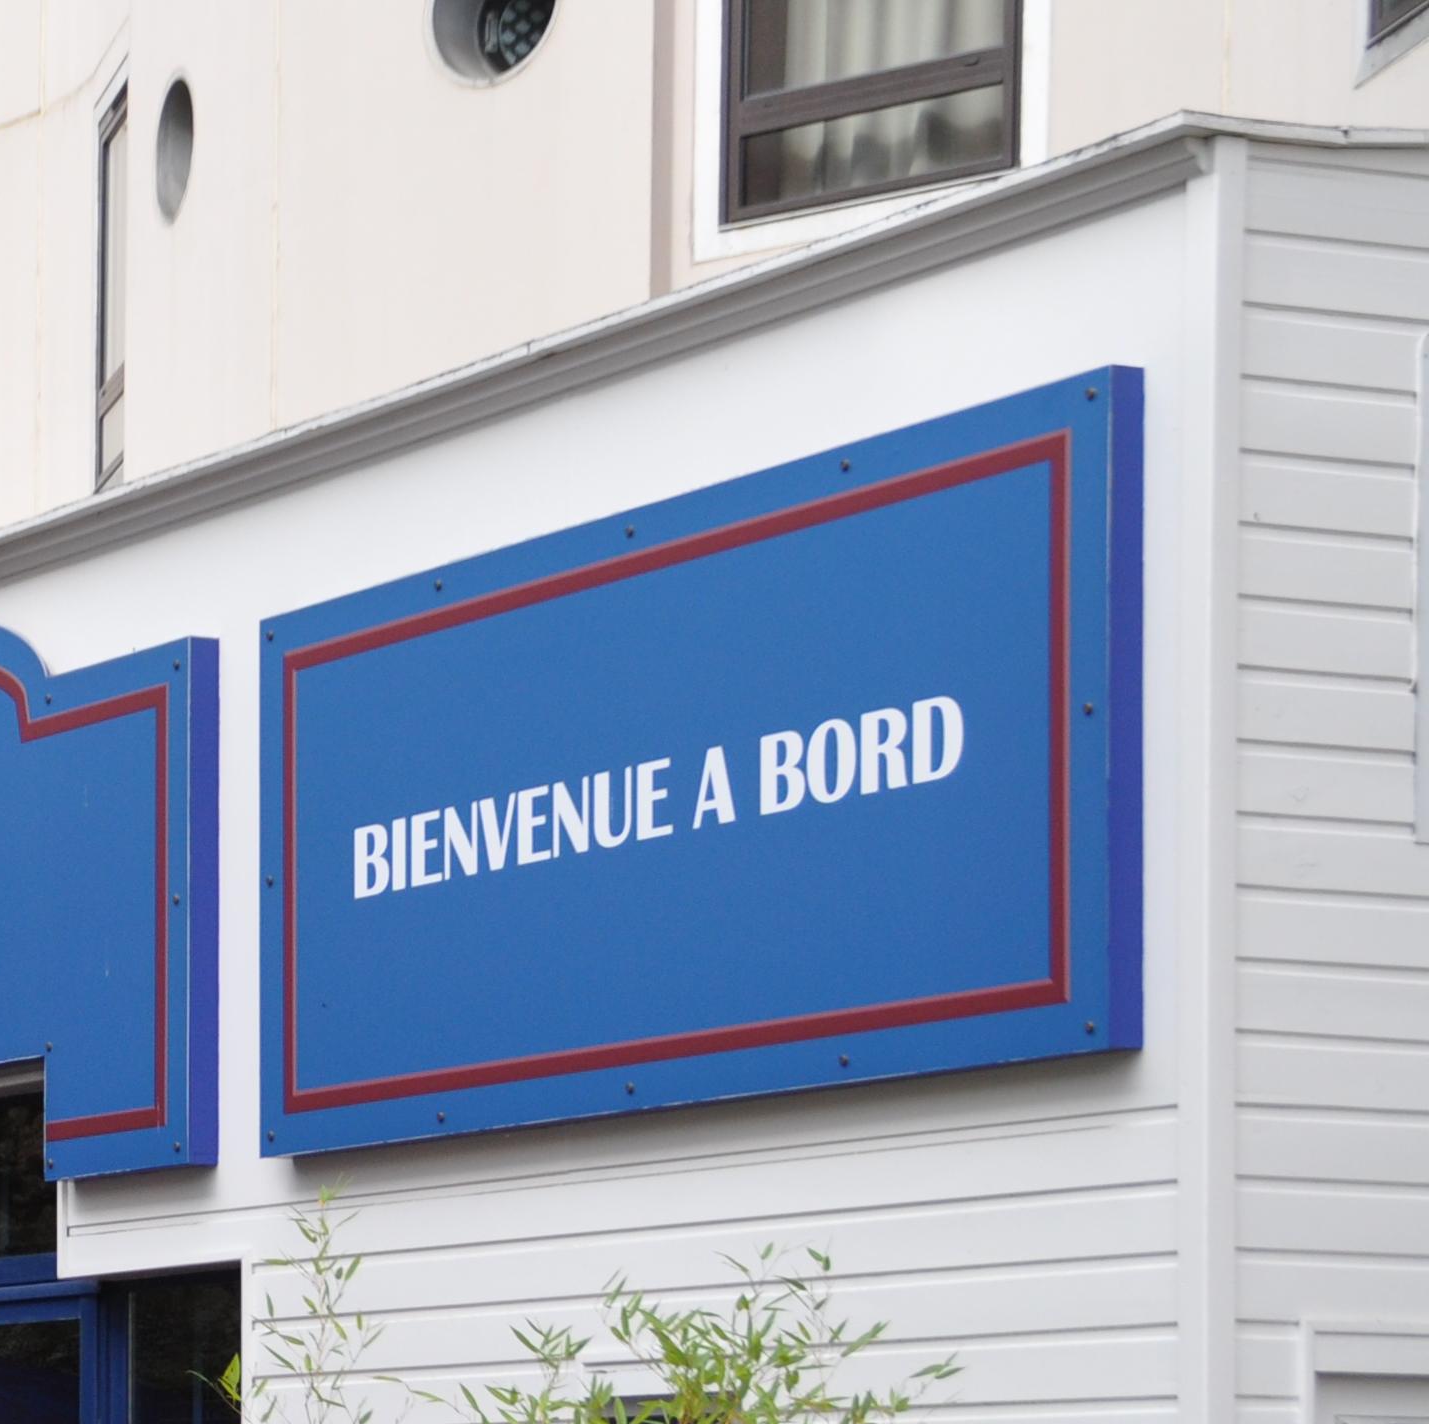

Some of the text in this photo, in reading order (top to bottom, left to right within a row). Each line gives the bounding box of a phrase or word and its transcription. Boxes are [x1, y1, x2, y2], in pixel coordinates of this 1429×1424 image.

[353, 695, 966, 900] BIENVENUE A BORD
